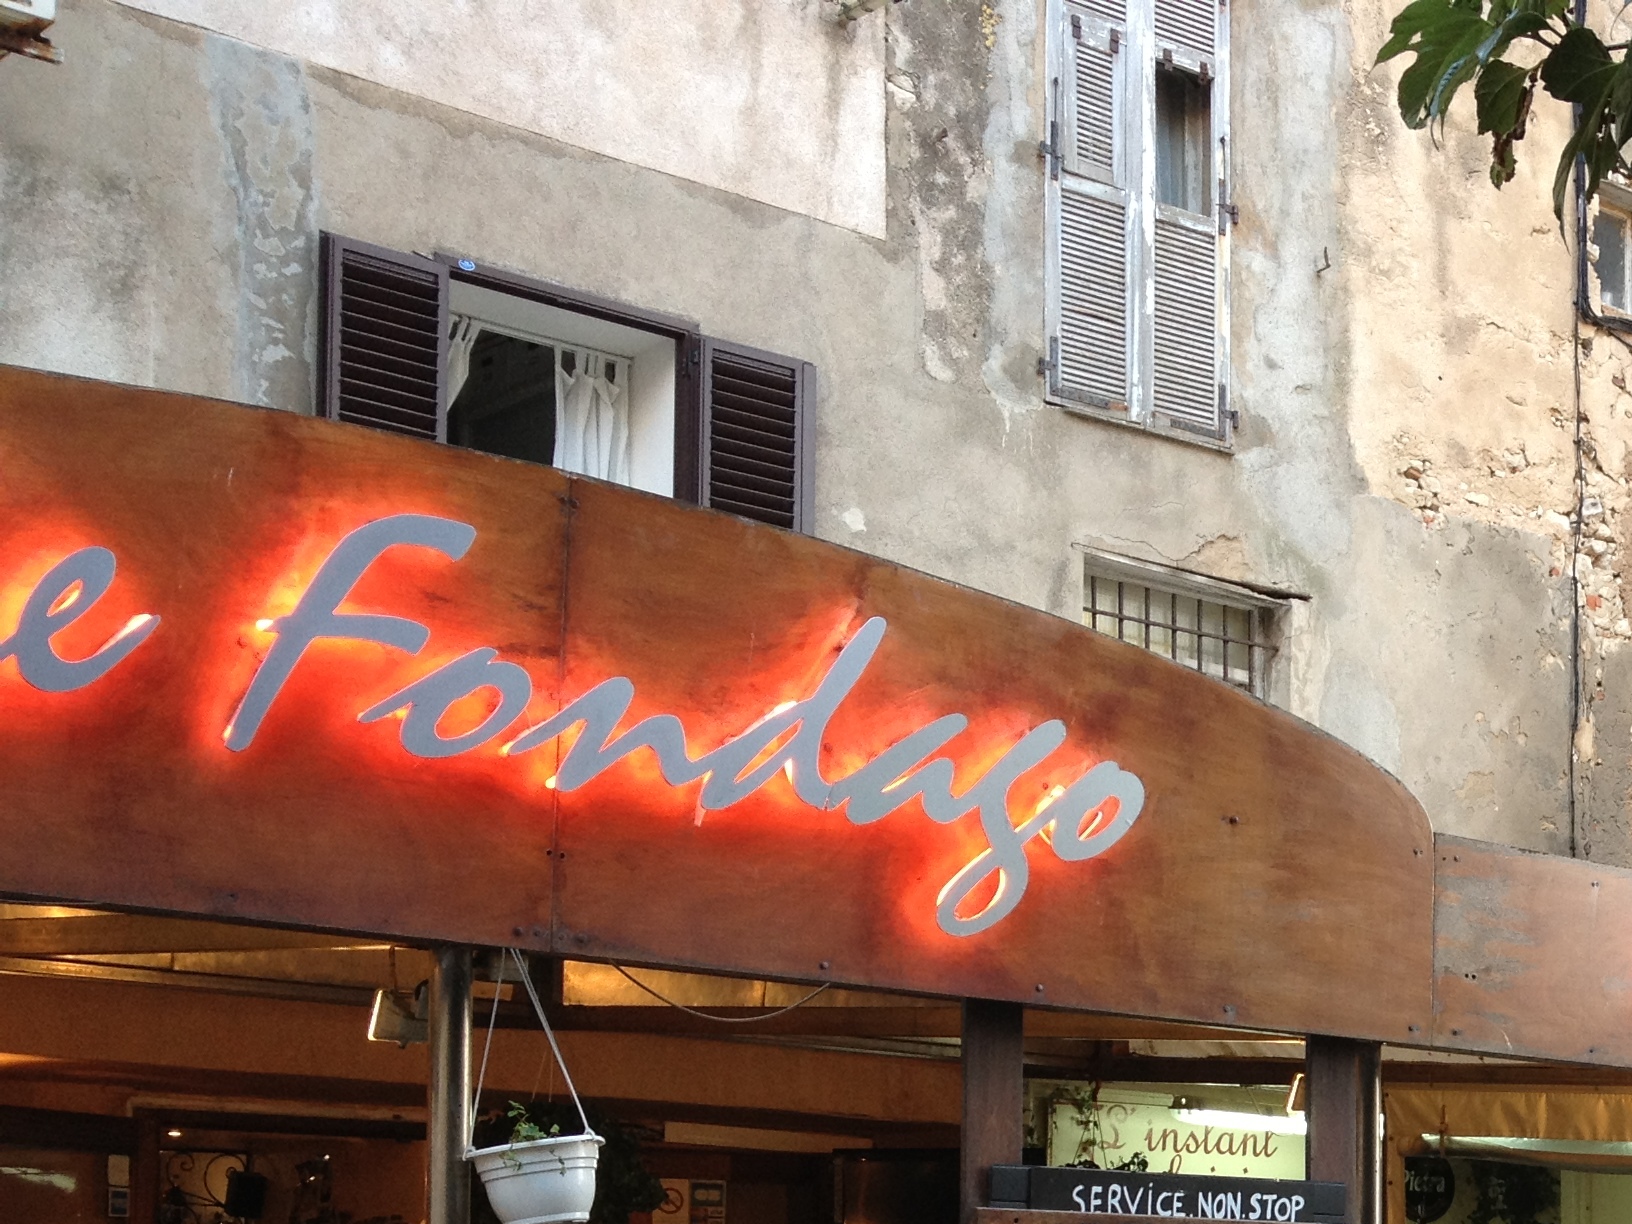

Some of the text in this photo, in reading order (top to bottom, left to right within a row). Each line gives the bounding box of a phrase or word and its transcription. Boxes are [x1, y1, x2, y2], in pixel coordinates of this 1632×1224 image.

[0, 513, 1146, 938] e Fondago
[1250, 1193, 1305, 1222] STOP
